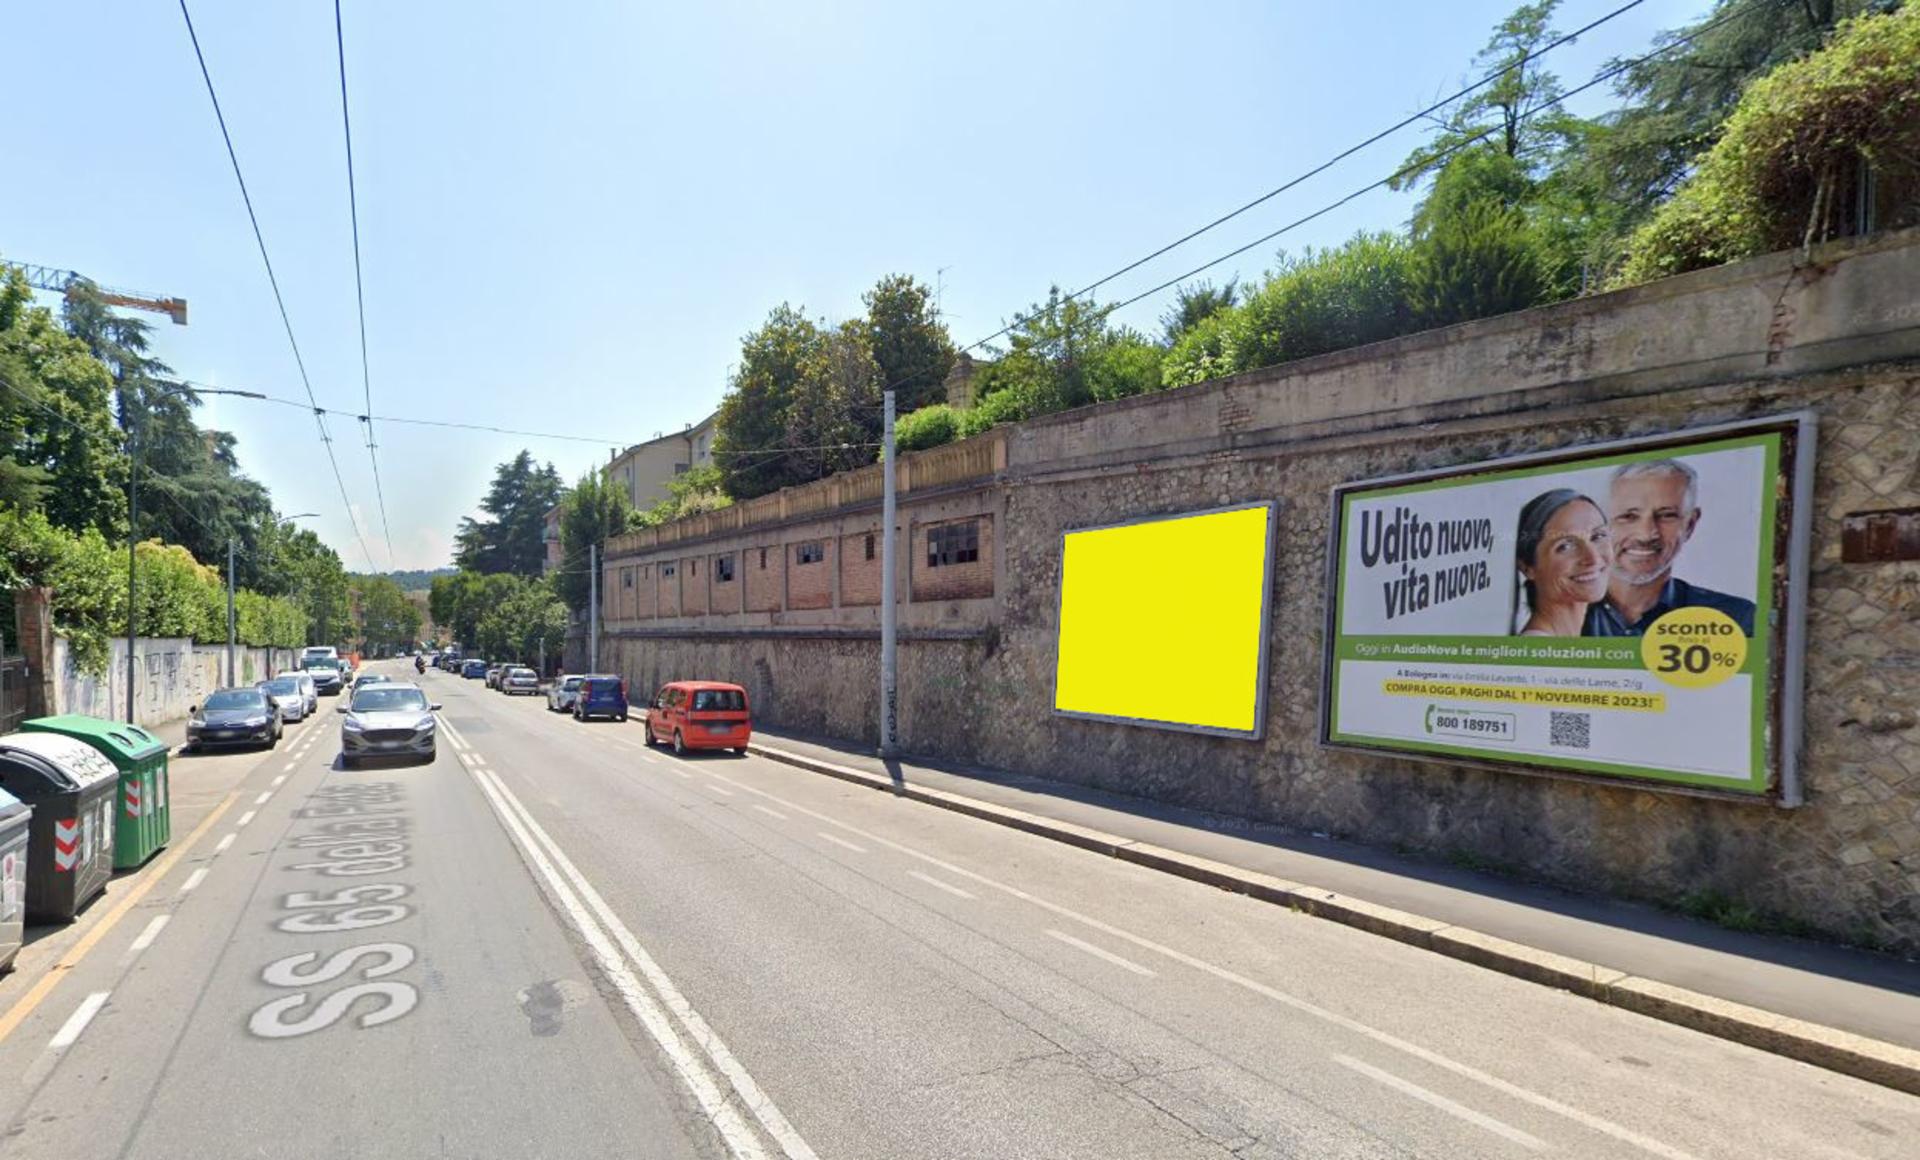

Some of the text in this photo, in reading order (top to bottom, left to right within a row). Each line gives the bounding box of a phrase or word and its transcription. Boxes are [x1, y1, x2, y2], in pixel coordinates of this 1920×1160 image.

[1361, 507, 1494, 567] Udito nuovo,
[1384, 560, 1490, 620] vita nuova.
[1656, 621, 1734, 636] sconto
[1393, 643, 1458, 655] AudioNova
[1461, 645, 1473, 656] le
[1475, 645, 1528, 659] migliori
[1531, 646, 1600, 660] soluzioni
[1605, 649, 1635, 661] con
[1386, 682, 1427, 694] COMPRA
[1460, 686, 1493, 698] PAGHI
[1495, 689, 1517, 700] DAL
[1535, 691, 1609, 706] NOVEMBRE
[1612, 695, 1653, 708] 2023!
[1437, 716, 1507, 733] 800 189751
